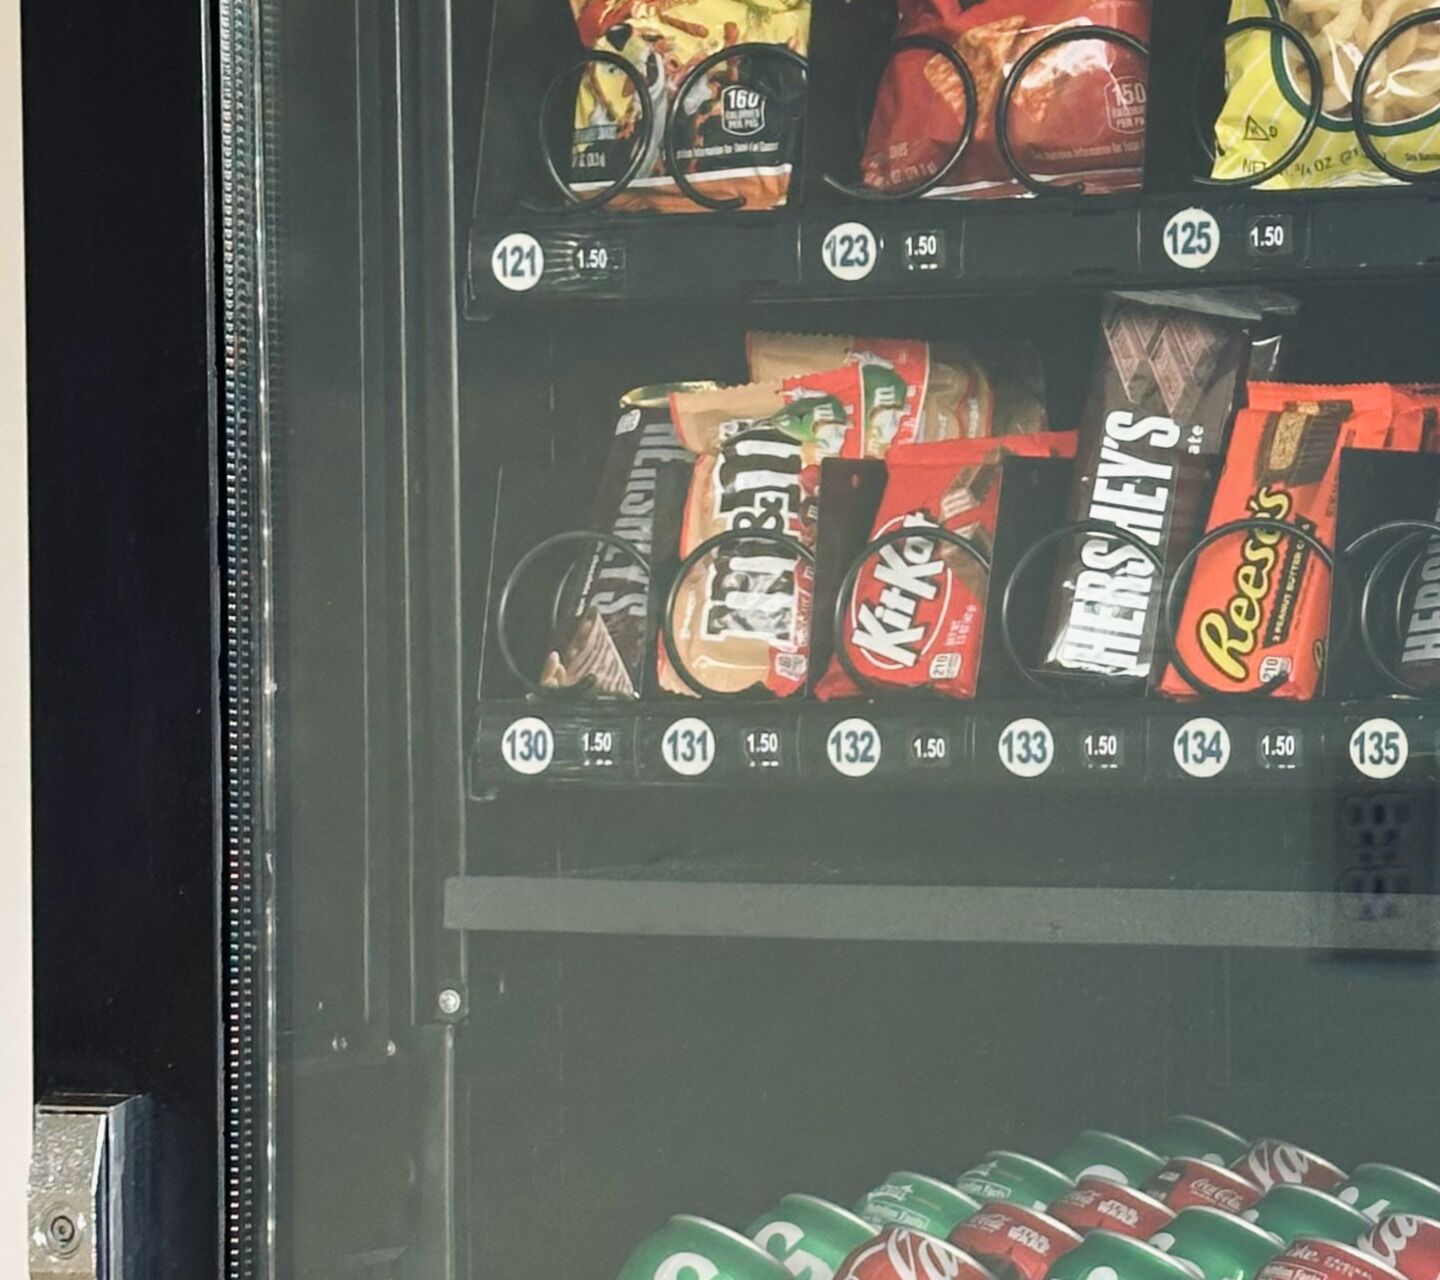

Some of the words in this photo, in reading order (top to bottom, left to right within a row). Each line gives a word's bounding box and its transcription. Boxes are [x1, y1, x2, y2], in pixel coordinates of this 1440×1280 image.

[825, 234, 870, 268] 123
[904, 234, 937, 256] 1.50
[1166, 222, 1212, 255] 125
[1250, 225, 1284, 248] 1.50
[497, 245, 537, 278] 121
[576, 248, 608, 269] 1.50
[1199, 486, 1292, 682] Reese's
[504, 728, 549, 762] 130
[581, 732, 612, 754] 1.50
[666, 729, 709, 763] 131
[747, 731, 779, 754] 1.50
[830, 730, 876, 764] 132
[913, 736, 946, 759] 1.50
[1001, 730, 1047, 764] 133
[1084, 736, 1118, 757] 1.50
[1175, 730, 1223, 765] 134
[1261, 736, 1296, 758] 1.50
[1352, 731, 1401, 766] 135
